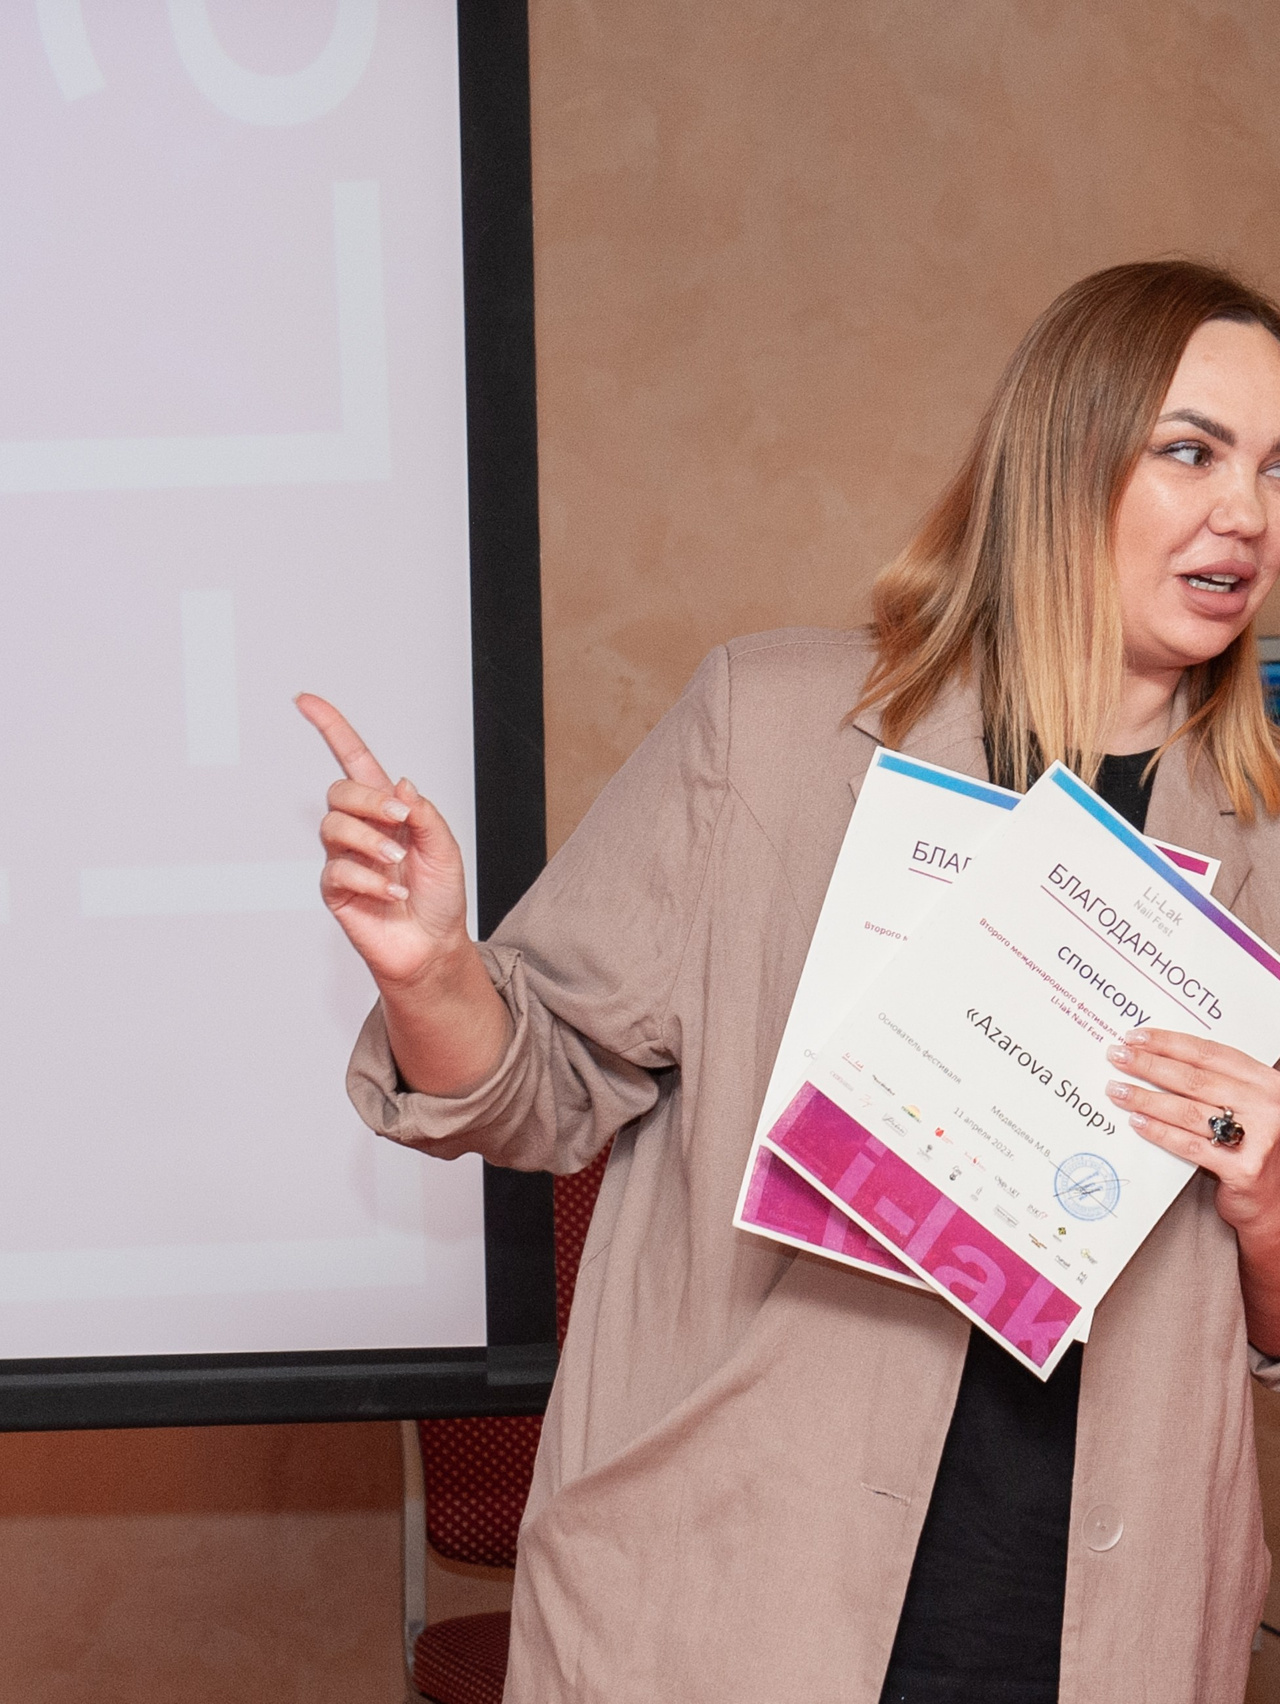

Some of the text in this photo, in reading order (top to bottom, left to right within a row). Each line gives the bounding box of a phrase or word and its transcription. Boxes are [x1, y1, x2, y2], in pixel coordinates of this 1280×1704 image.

[1133, 899, 1175, 938] Nail Fest
[1142, 886, 1184, 928] Li-Lak
[1047, 862, 1224, 1020] БЛАГОДАРНОСТЬ
[979, 917, 1118, 1038] Второго международного фестиваля
[1057, 945, 1152, 1028] спонсору
[878, 1011, 922, 1052] Основатель
[921, 1048, 963, 1085] фестиваля
[1070, 1012, 1089, 1029] Nail
[1086, 1025, 1105, 1043] Fest
[966, 1008, 1116, 1136] «Azarova Shop»
[953, 1106, 965, 1119] 11
[963, 1116, 992, 1141] апреля
[990, 1105, 1035, 1145] Медведева
